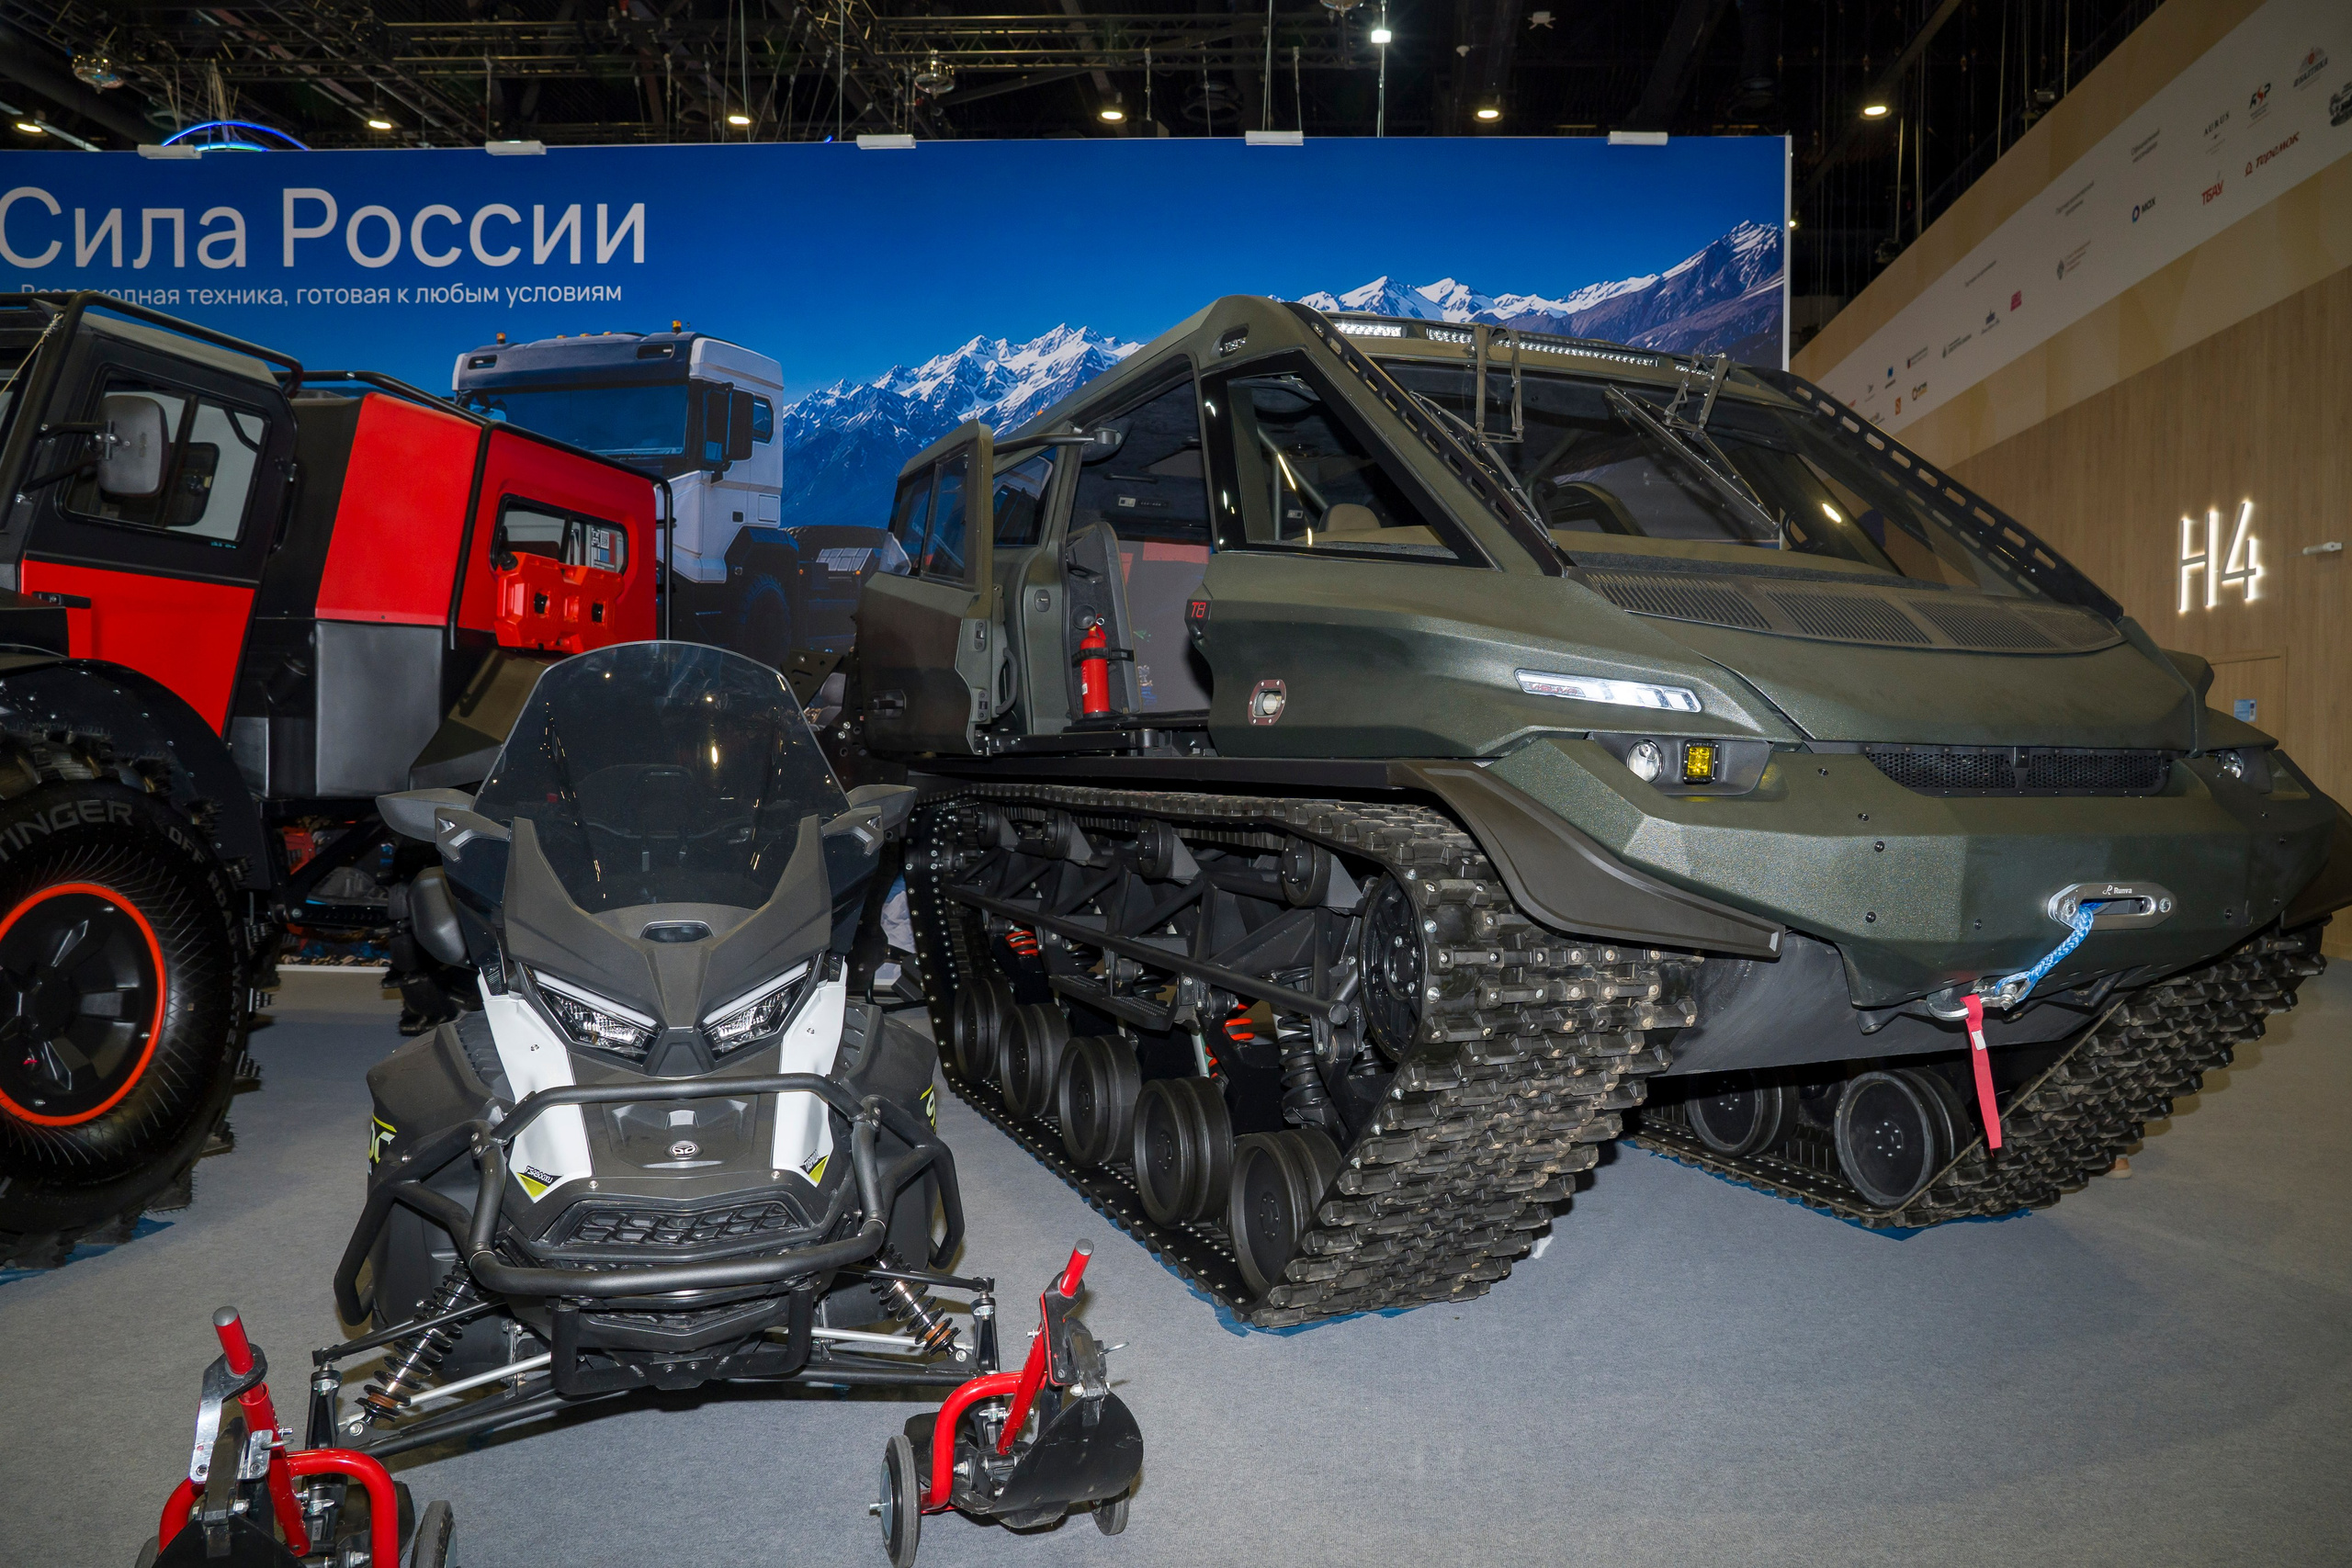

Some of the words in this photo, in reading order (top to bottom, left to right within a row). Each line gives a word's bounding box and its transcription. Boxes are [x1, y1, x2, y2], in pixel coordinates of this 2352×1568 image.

[2203, 111, 2230, 137] AURUS
[0, 186, 246, 269] Сила
[283, 187, 645, 268] России
[187, 288, 288, 307] техника,
[297, 288, 390, 303] готовая
[398, 288, 408, 303] к
[415, 283, 498, 304] любым
[505, 287, 621, 308] условиям
[2177, 501, 2264, 612] H4
[1191, 601, 1207, 618] T8
[169, 826, 206, 864] OFF
[2113, 886, 2132, 895] Runva
